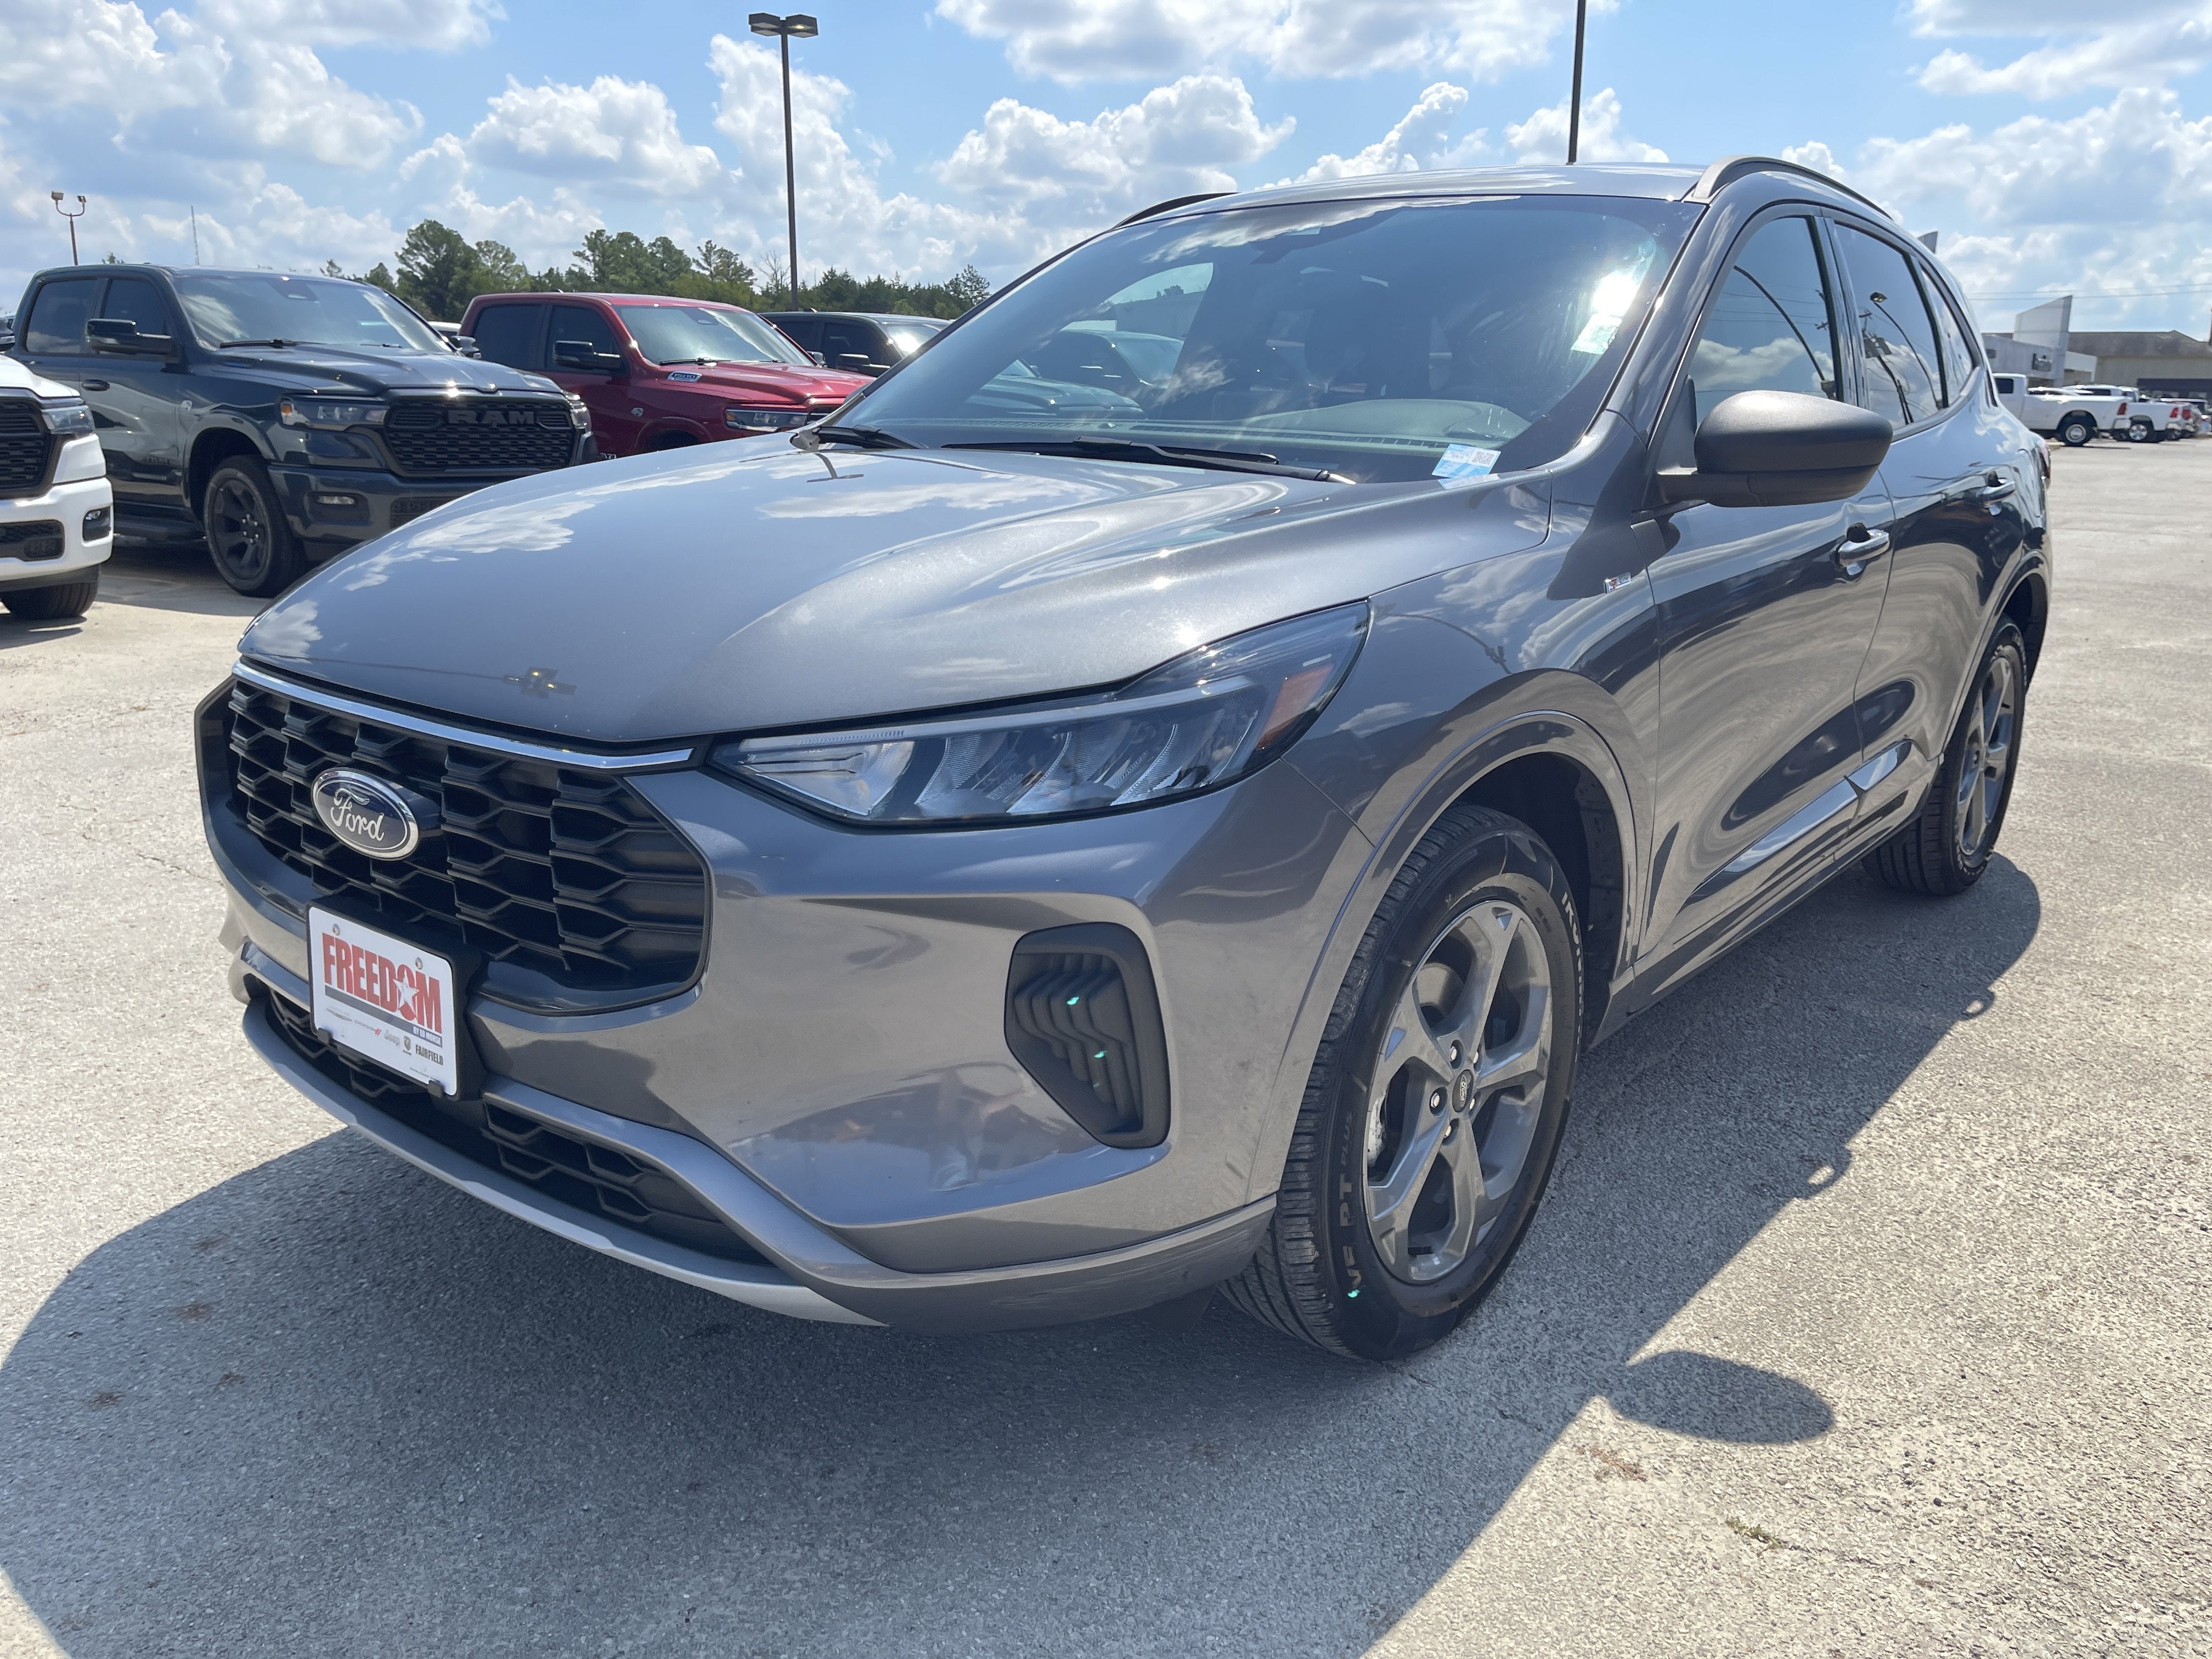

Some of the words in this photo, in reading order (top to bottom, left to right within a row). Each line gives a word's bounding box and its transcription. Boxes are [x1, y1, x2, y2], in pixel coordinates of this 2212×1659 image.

[448, 410, 534, 425] RAM
[331, 788, 385, 842] Ford
[321, 932, 442, 1035] FREEDOM
[415, 1044, 443, 1065] FAIRFIELD
